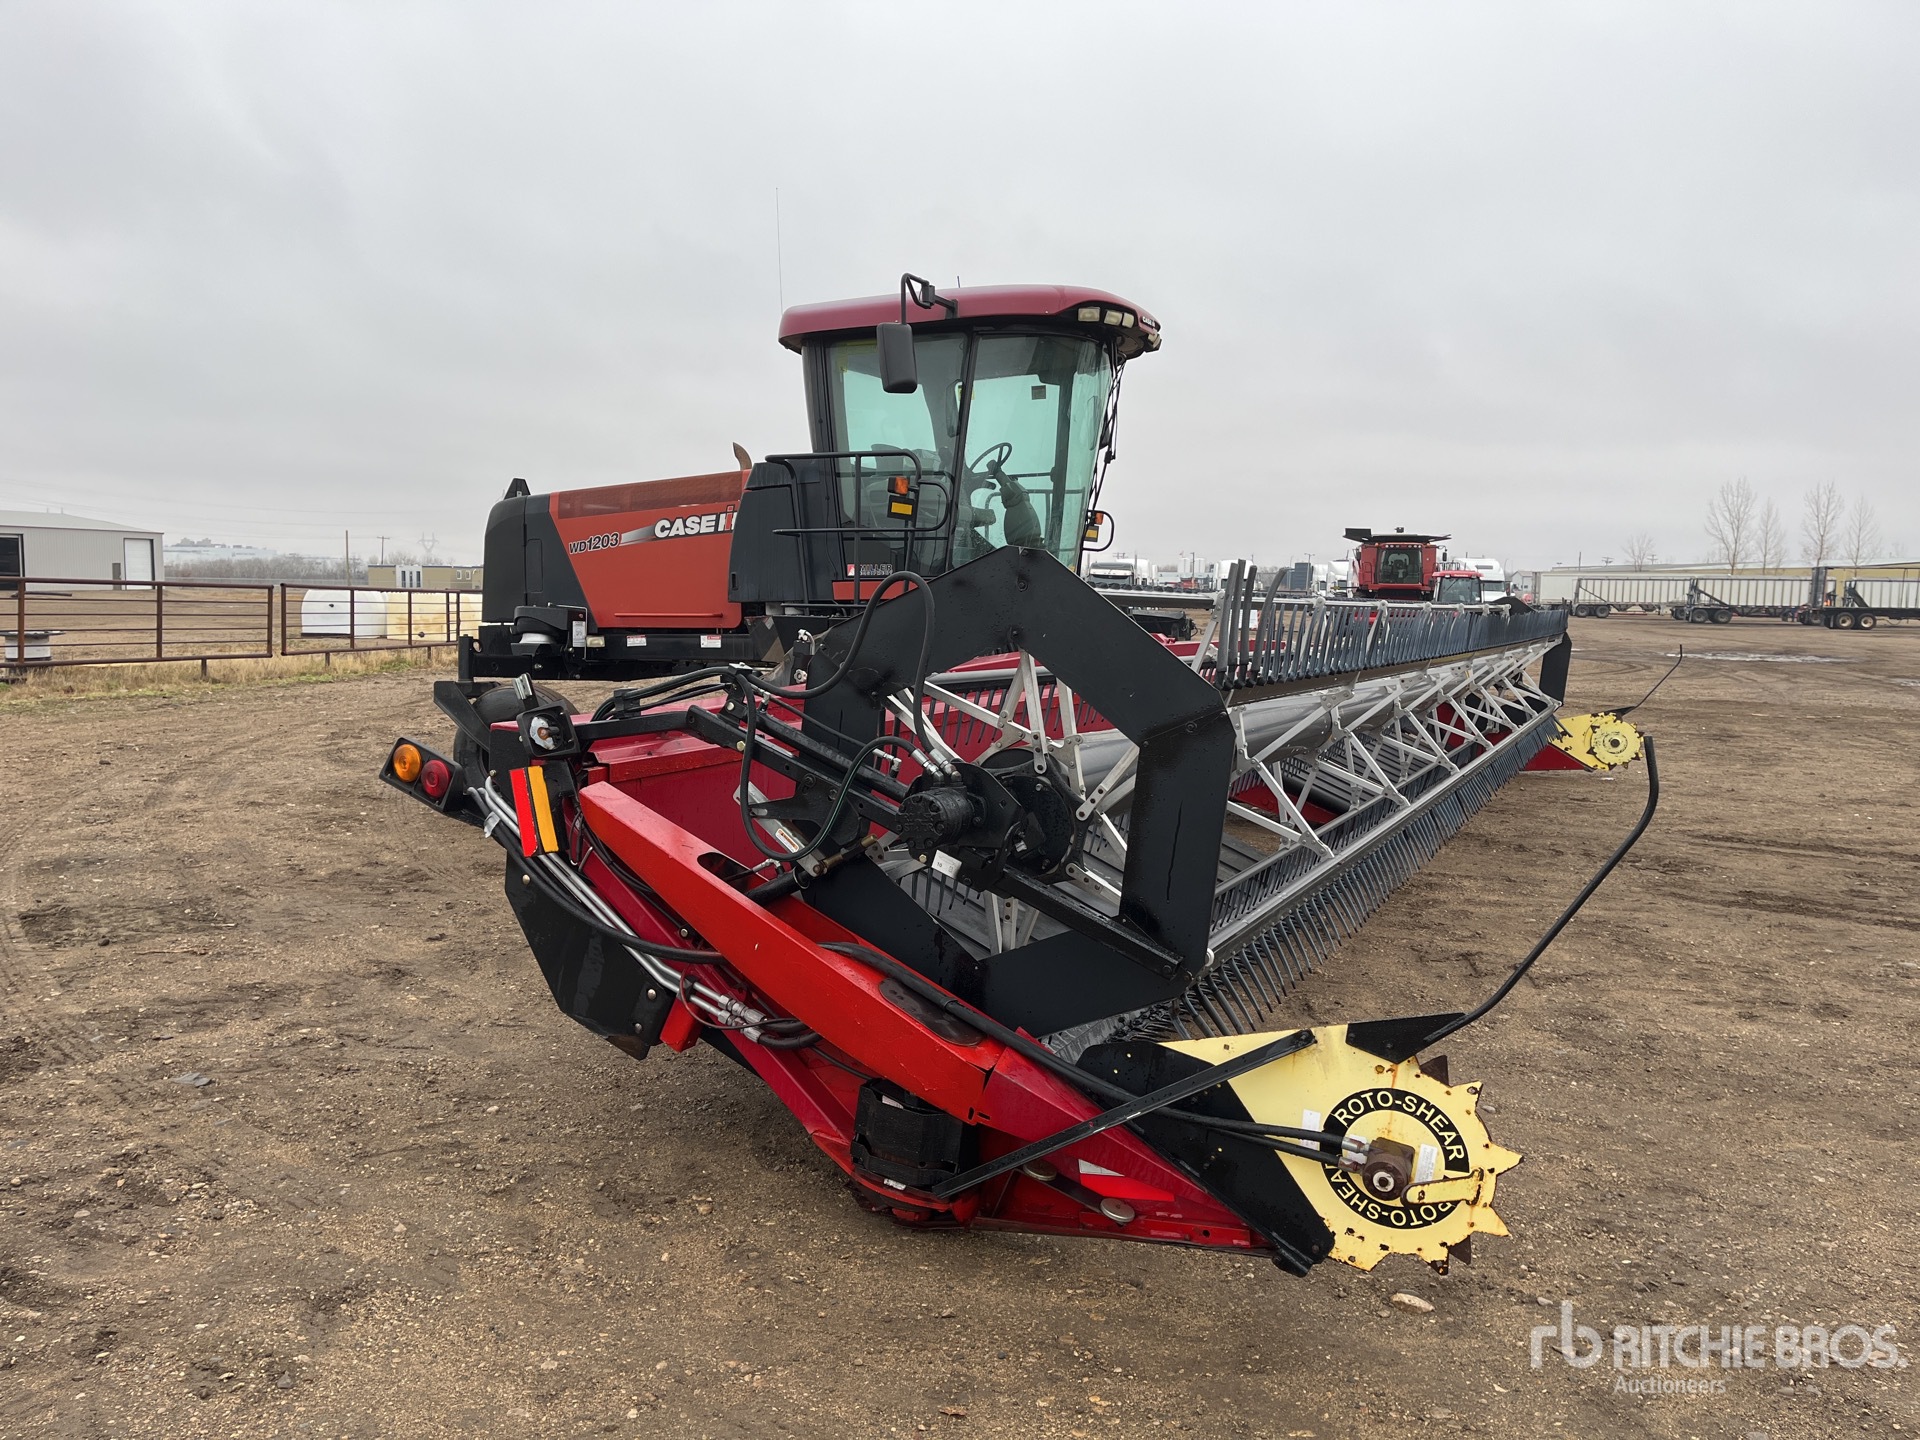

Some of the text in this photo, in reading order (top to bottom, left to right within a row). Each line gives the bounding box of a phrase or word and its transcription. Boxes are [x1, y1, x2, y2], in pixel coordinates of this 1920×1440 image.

[569, 532, 620, 555] WD1203
[654, 514, 716, 538] CASE
[1333, 1090, 1465, 1162] ROTO-SHEAR
[1325, 1163, 1451, 1227] OTO-SHEA
